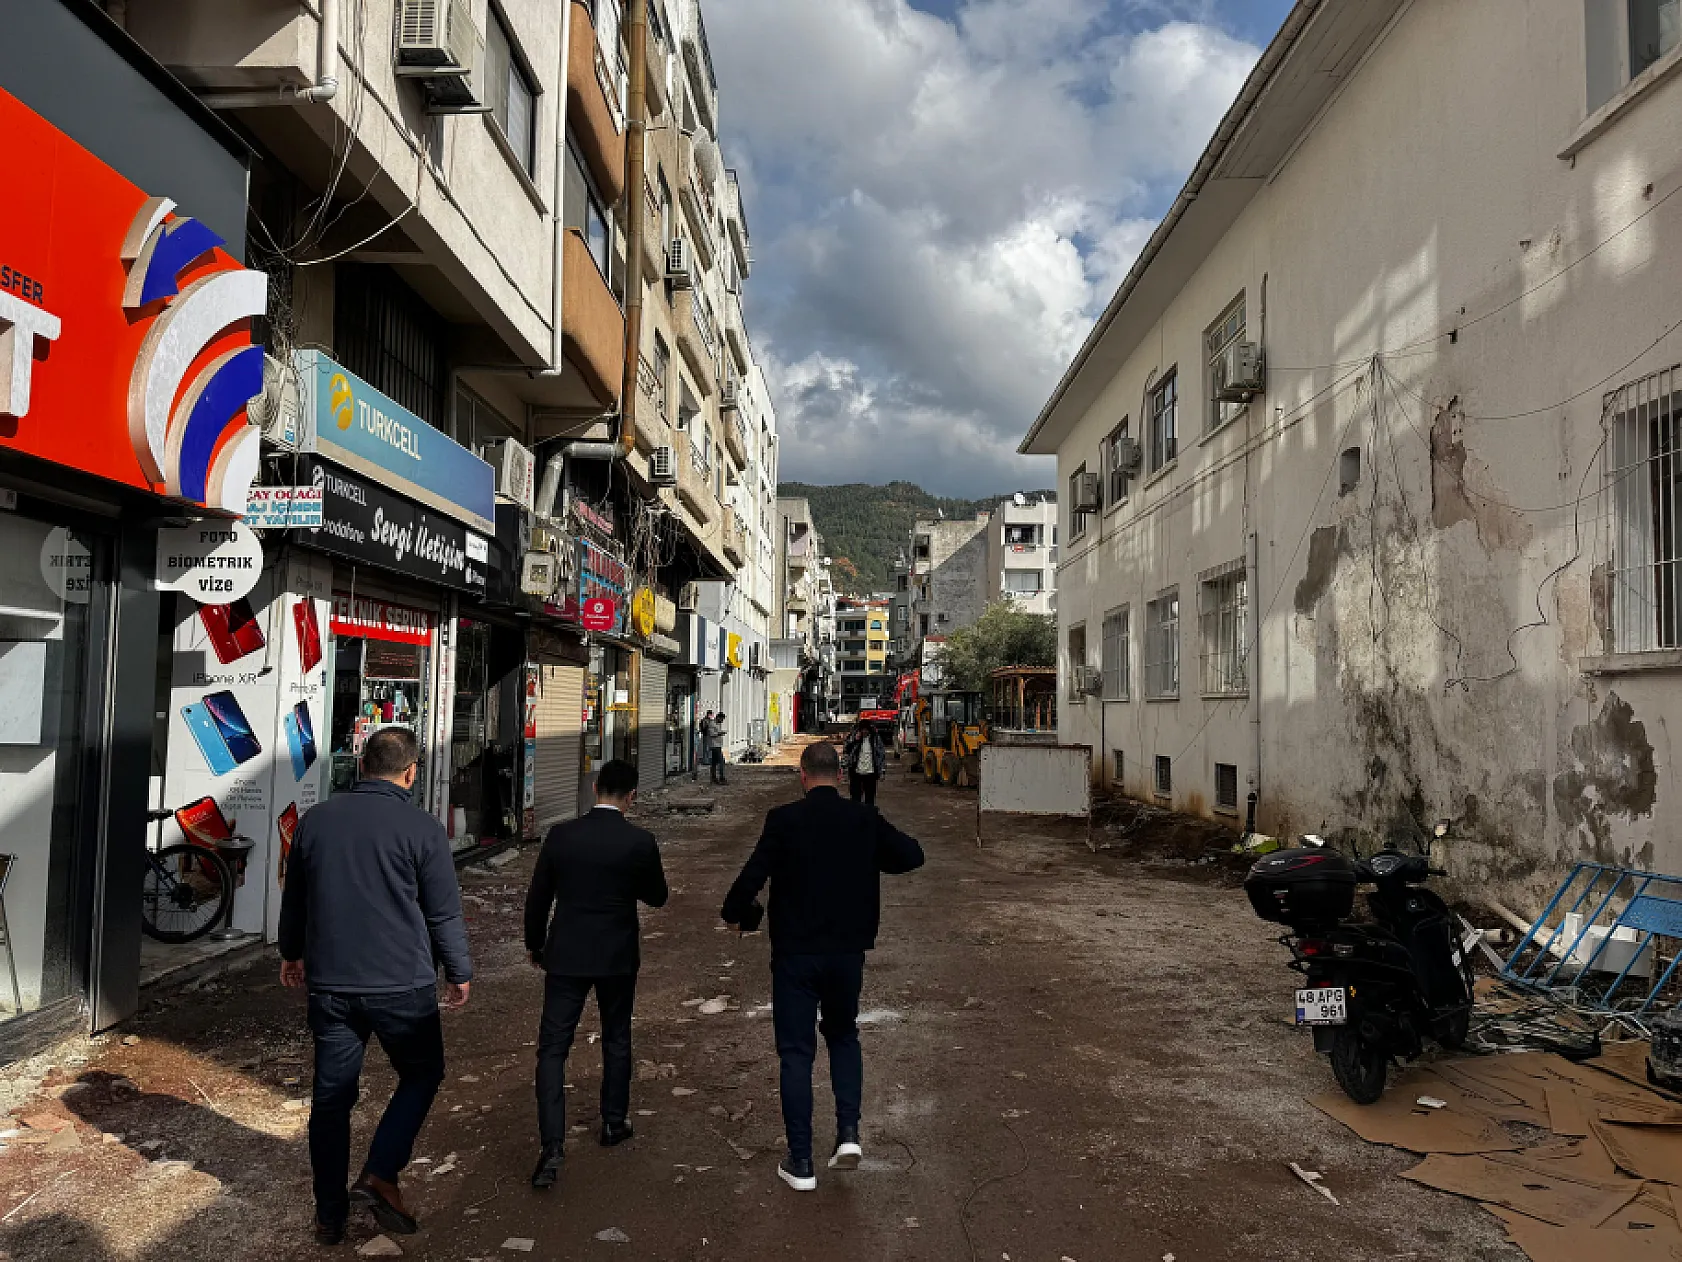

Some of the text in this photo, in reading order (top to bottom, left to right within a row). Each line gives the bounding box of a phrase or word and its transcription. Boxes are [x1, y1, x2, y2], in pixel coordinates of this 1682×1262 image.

[357, 398, 422, 461] TURKCELL
[325, 473, 367, 507] TURKCELL
[200, 531, 238, 543] FOTO
[323, 518, 365, 545] vodafone
[371, 506, 413, 561] Sevgi
[238, 673, 257, 684] XR
[1299, 990, 1342, 1003] 48 APG
[1321, 1004, 1344, 1018] 961
